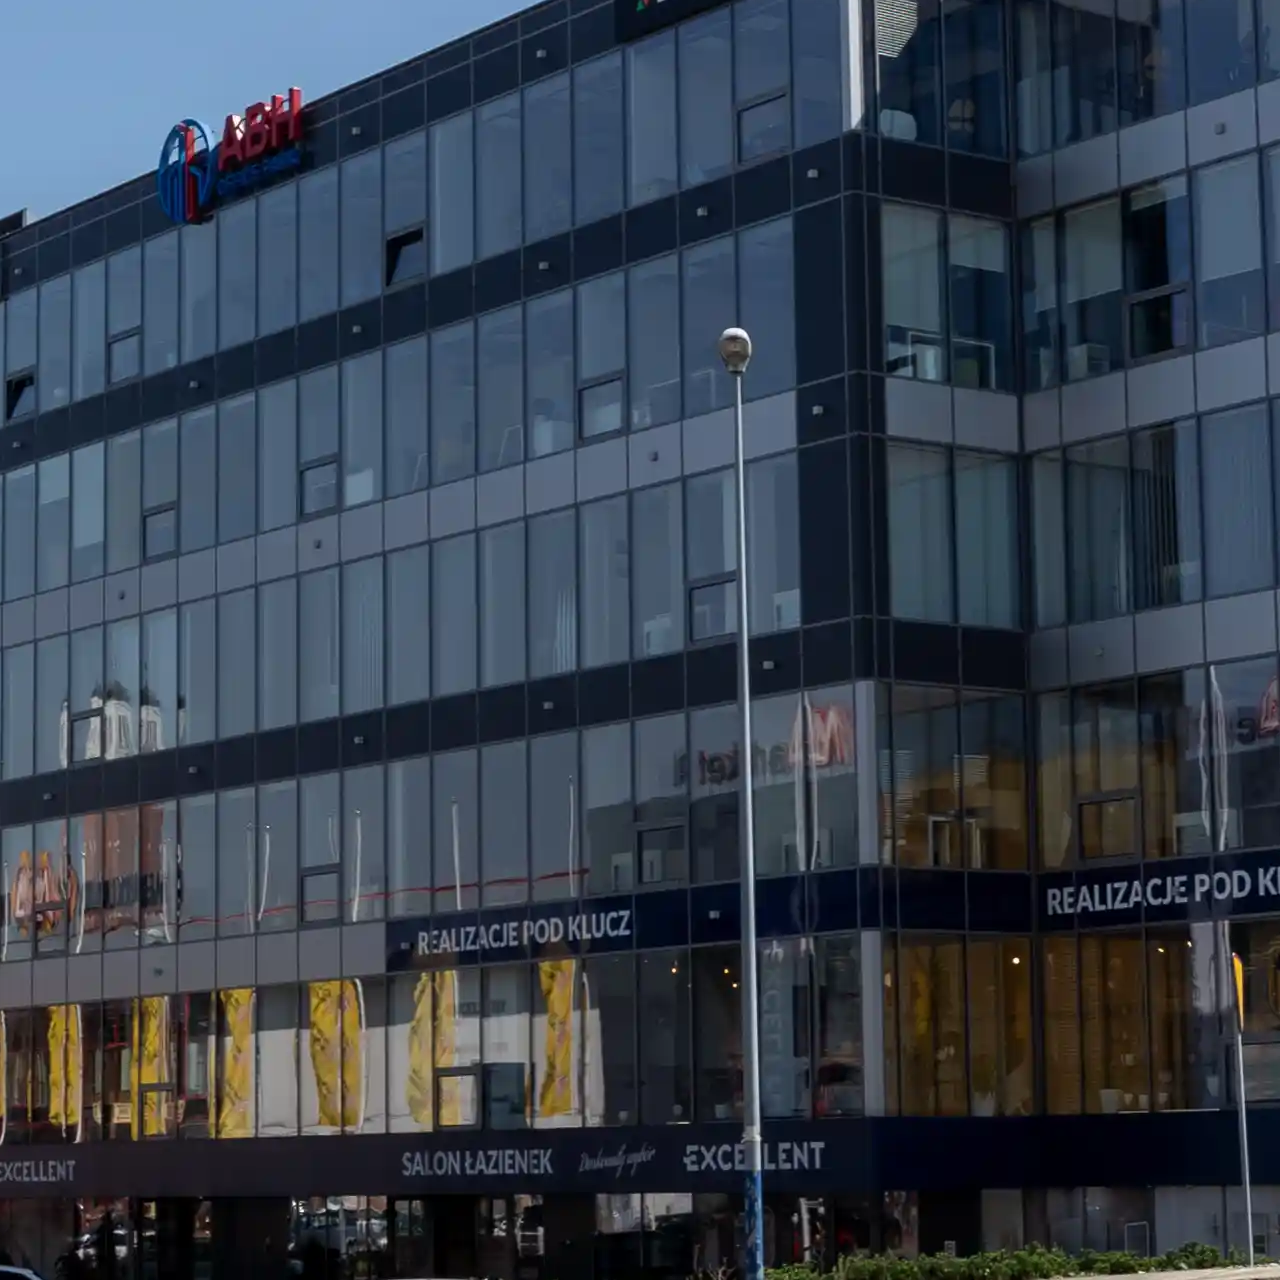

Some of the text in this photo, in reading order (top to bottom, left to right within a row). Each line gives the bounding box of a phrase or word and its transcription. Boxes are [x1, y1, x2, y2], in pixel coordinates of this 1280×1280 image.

[218, 87, 303, 171] ABH
[1047, 874, 1188, 916] REALIZACJE
[1195, 870, 1252, 902] POD
[417, 910, 632, 956] REALIZACJE POD KLUCZ
[401, 1147, 554, 1177] SALON ŁAZIENEK
[683, 1140, 826, 1173] EXCELENT
